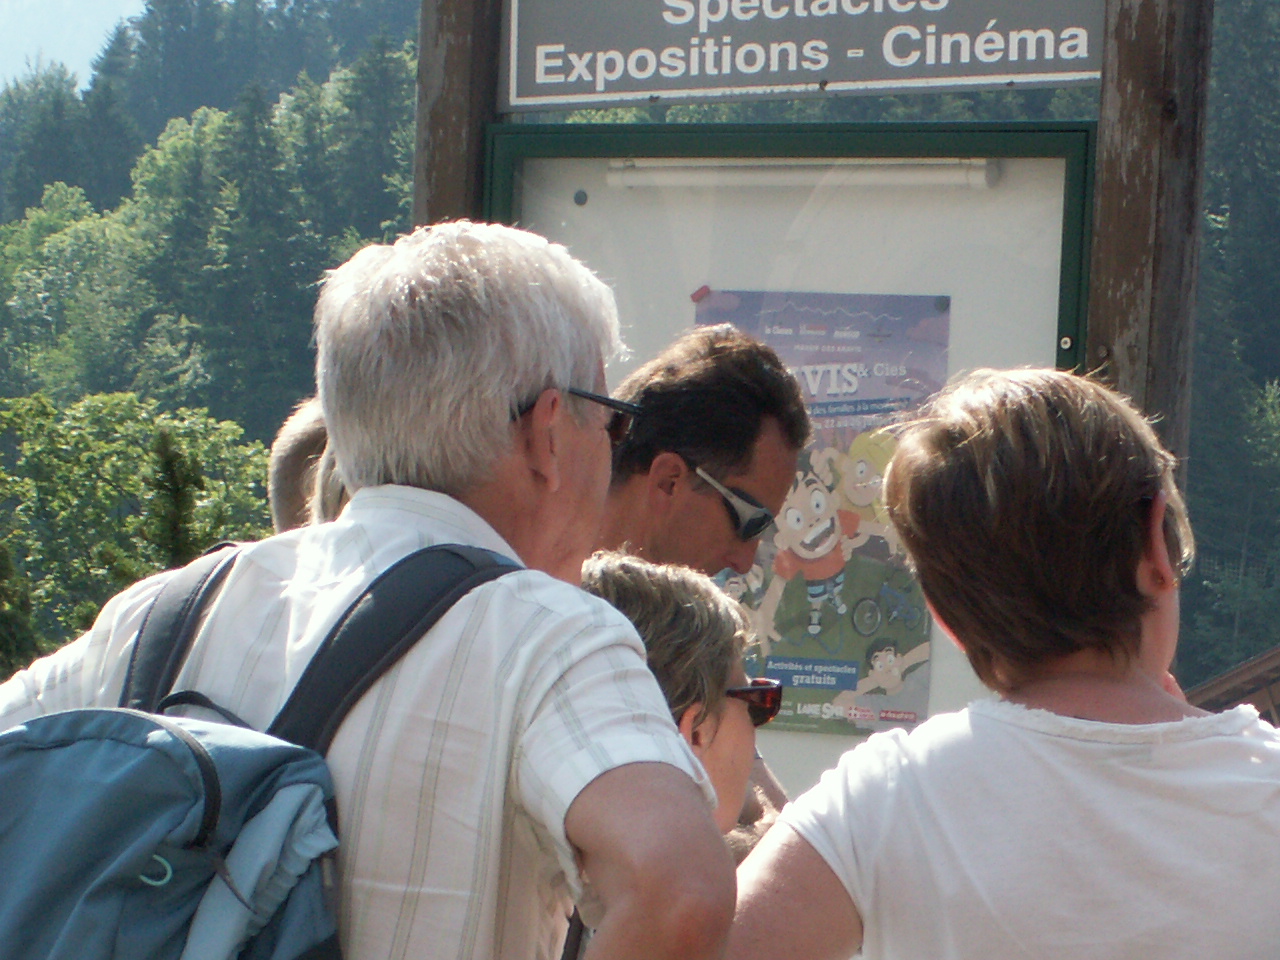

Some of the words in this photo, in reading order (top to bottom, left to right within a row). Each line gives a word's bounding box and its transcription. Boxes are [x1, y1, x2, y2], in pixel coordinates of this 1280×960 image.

[535, 36, 829, 92] Expositions
[847, 49, 864, 58] -
[882, 19, 1089, 67] Cinéma
[791, 362, 859, 396] VIS
[874, 363, 907, 377] Cies
[767, 660, 803, 671] Activités
[814, 664, 857, 674] spectacles
[792, 674, 837, 686] gratuits
